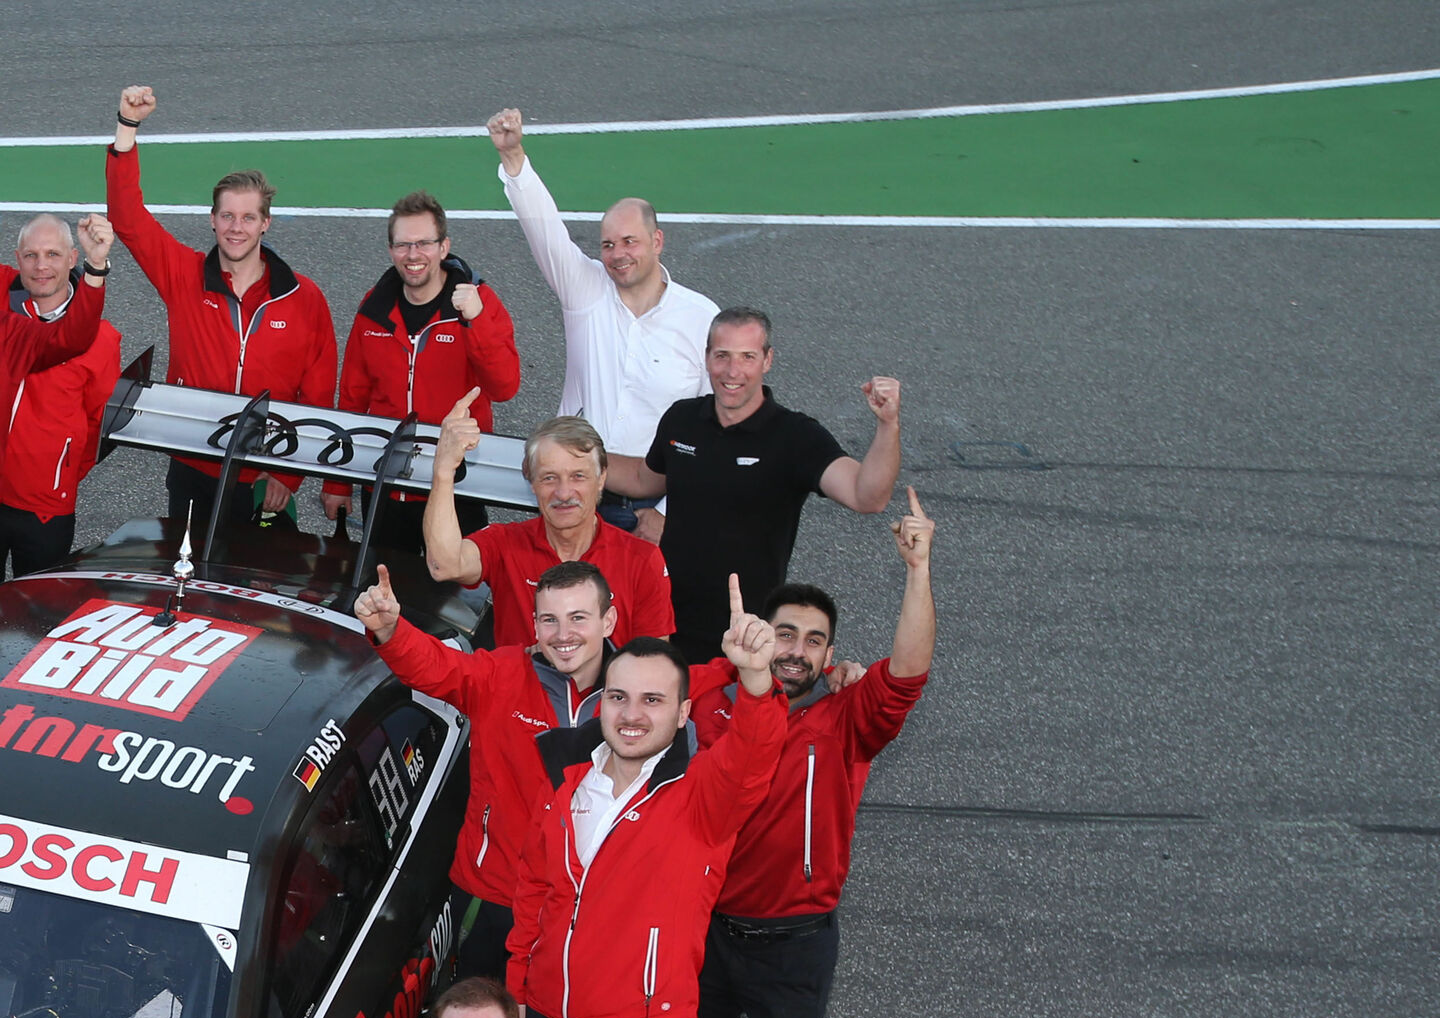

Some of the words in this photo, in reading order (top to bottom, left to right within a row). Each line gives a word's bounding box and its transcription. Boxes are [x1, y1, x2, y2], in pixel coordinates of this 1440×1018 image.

[45, 604, 249, 666] Auto
[18, 638, 210, 714] Bild
[306, 718, 348, 771] RAST
